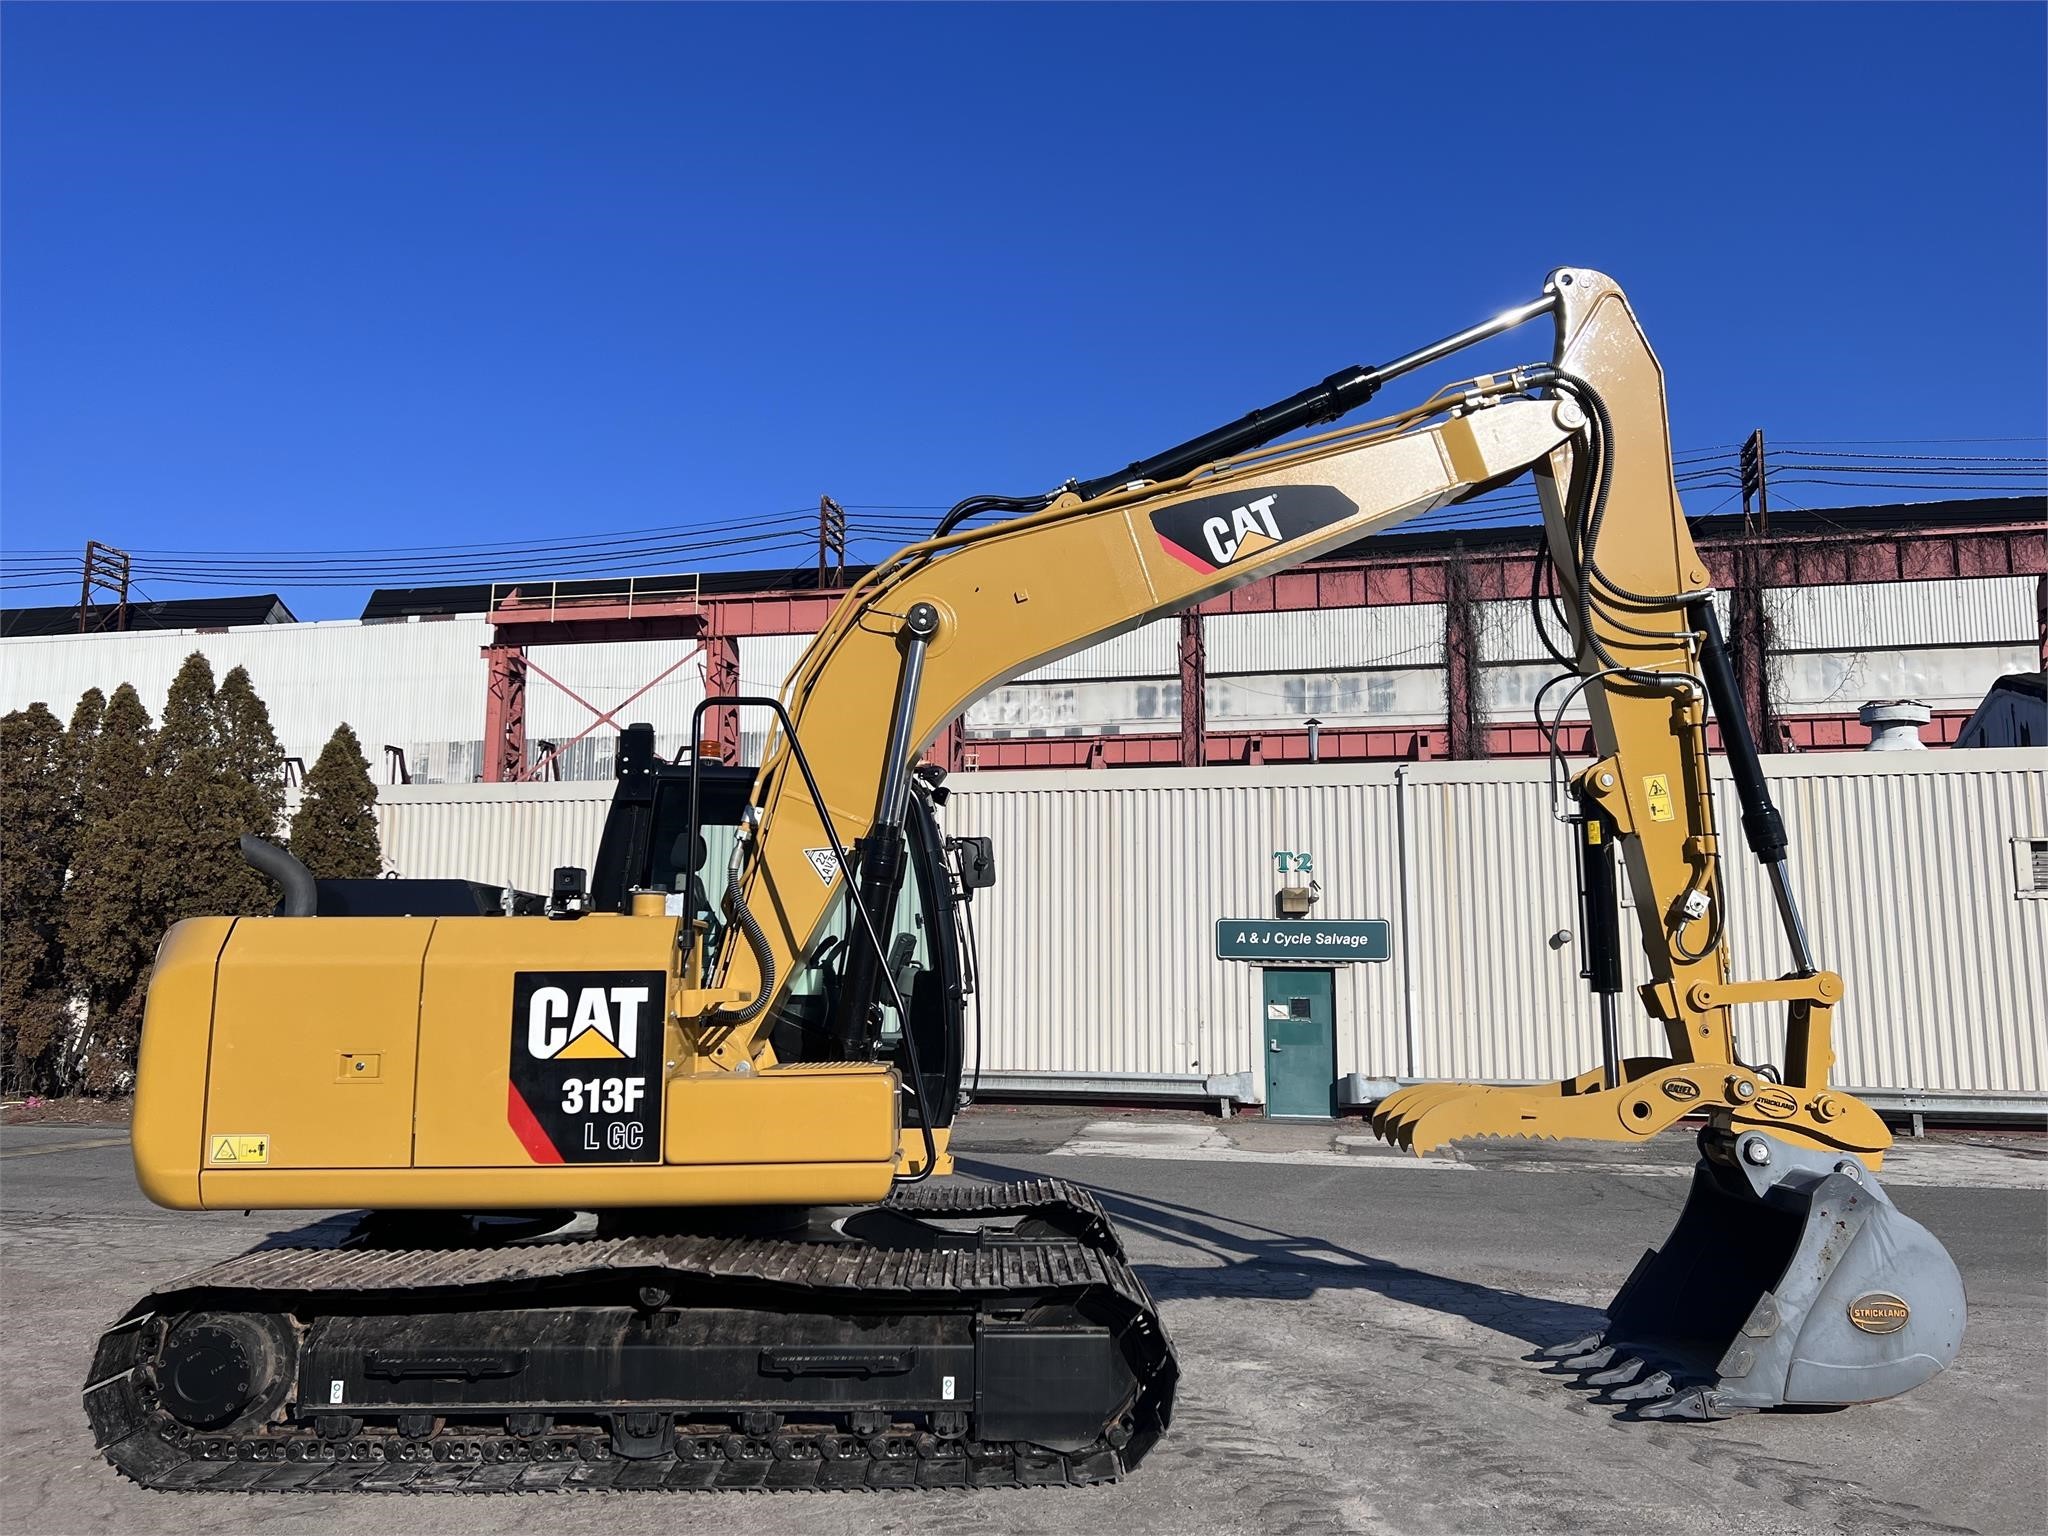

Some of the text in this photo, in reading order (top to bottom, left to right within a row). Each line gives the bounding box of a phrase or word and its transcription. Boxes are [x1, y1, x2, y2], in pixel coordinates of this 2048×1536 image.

[1203, 495, 1283, 564] CAT
[815, 852, 828, 865] 22
[1272, 851, 1313, 873] T2
[1236, 932, 1368, 948] A & J Cycle Salvage
[528, 986, 649, 1060] CAT
[561, 1077, 645, 1114] 313F
[584, 1122, 644, 1150] L GC
[1854, 1308, 1906, 1317] STRICKLAND
